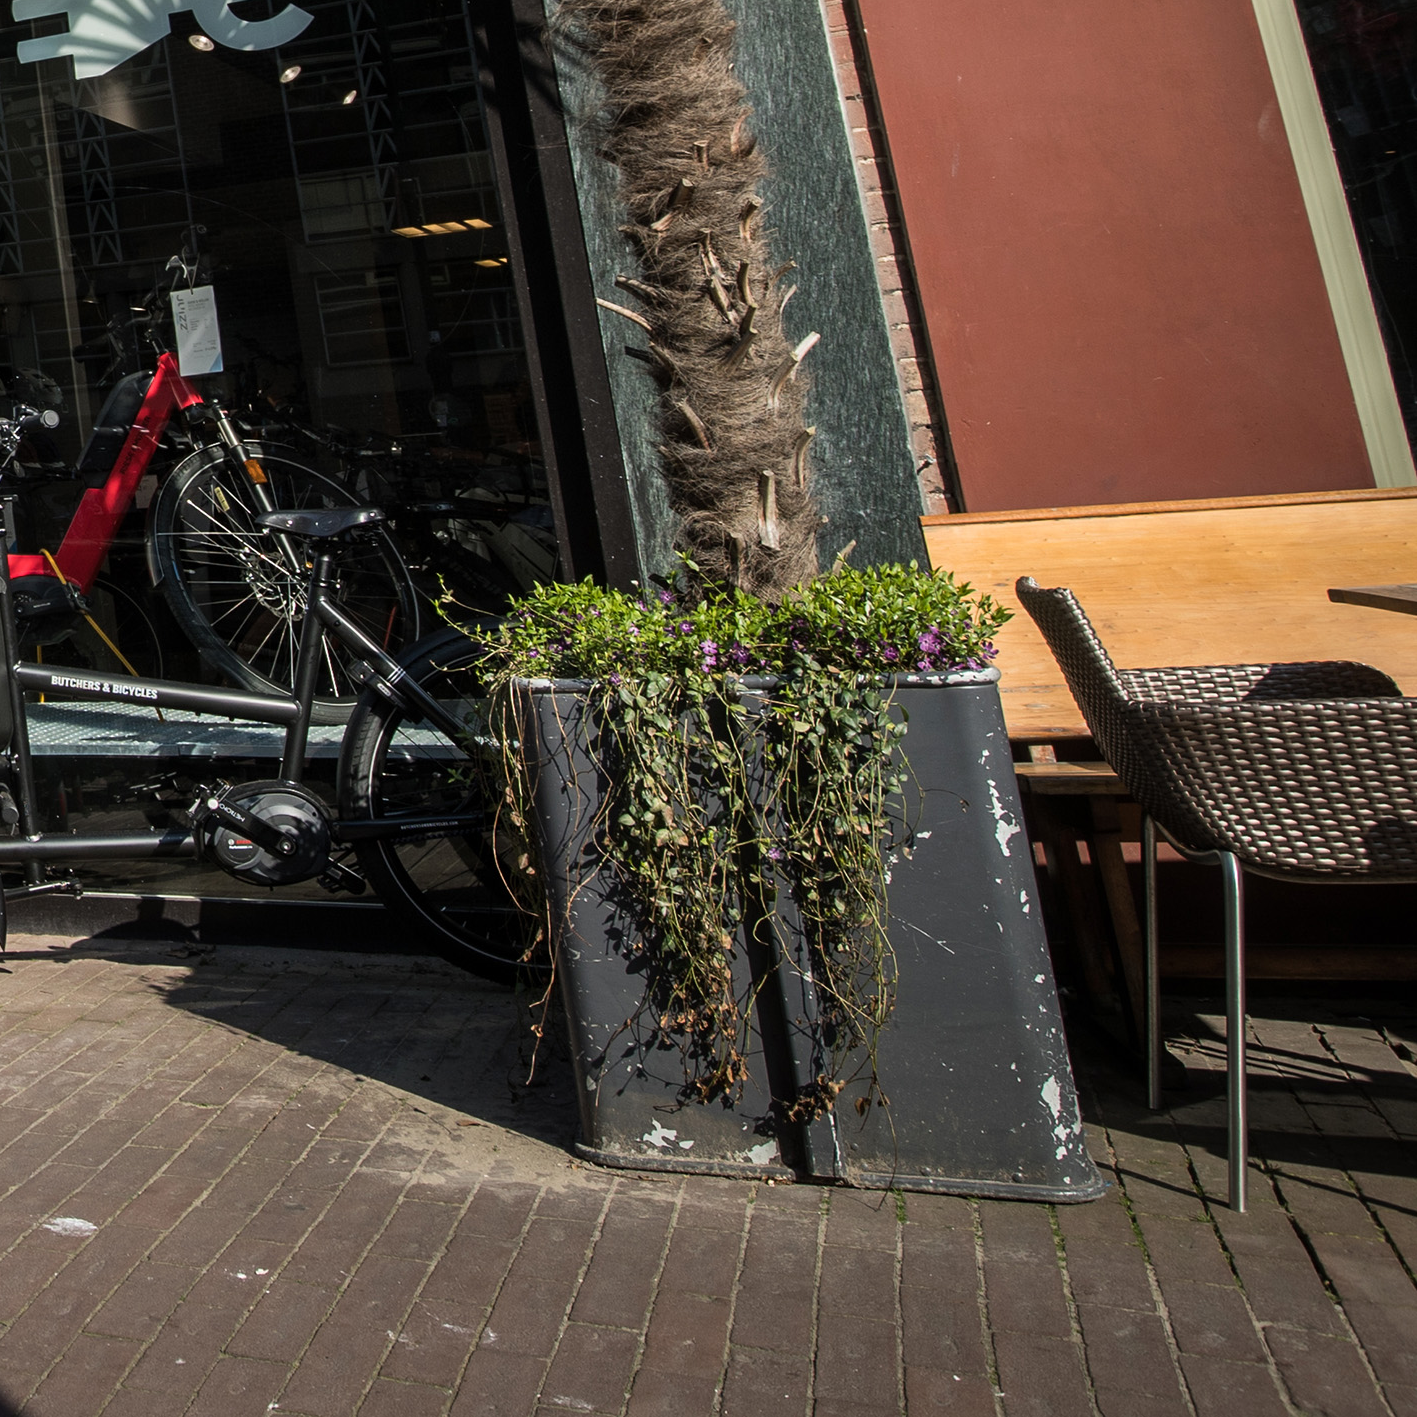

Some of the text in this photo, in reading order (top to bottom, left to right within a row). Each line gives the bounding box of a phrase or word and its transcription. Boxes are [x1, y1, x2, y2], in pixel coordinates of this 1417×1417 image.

[51, 675, 158, 700] BUTCHERS & BICYCLES
